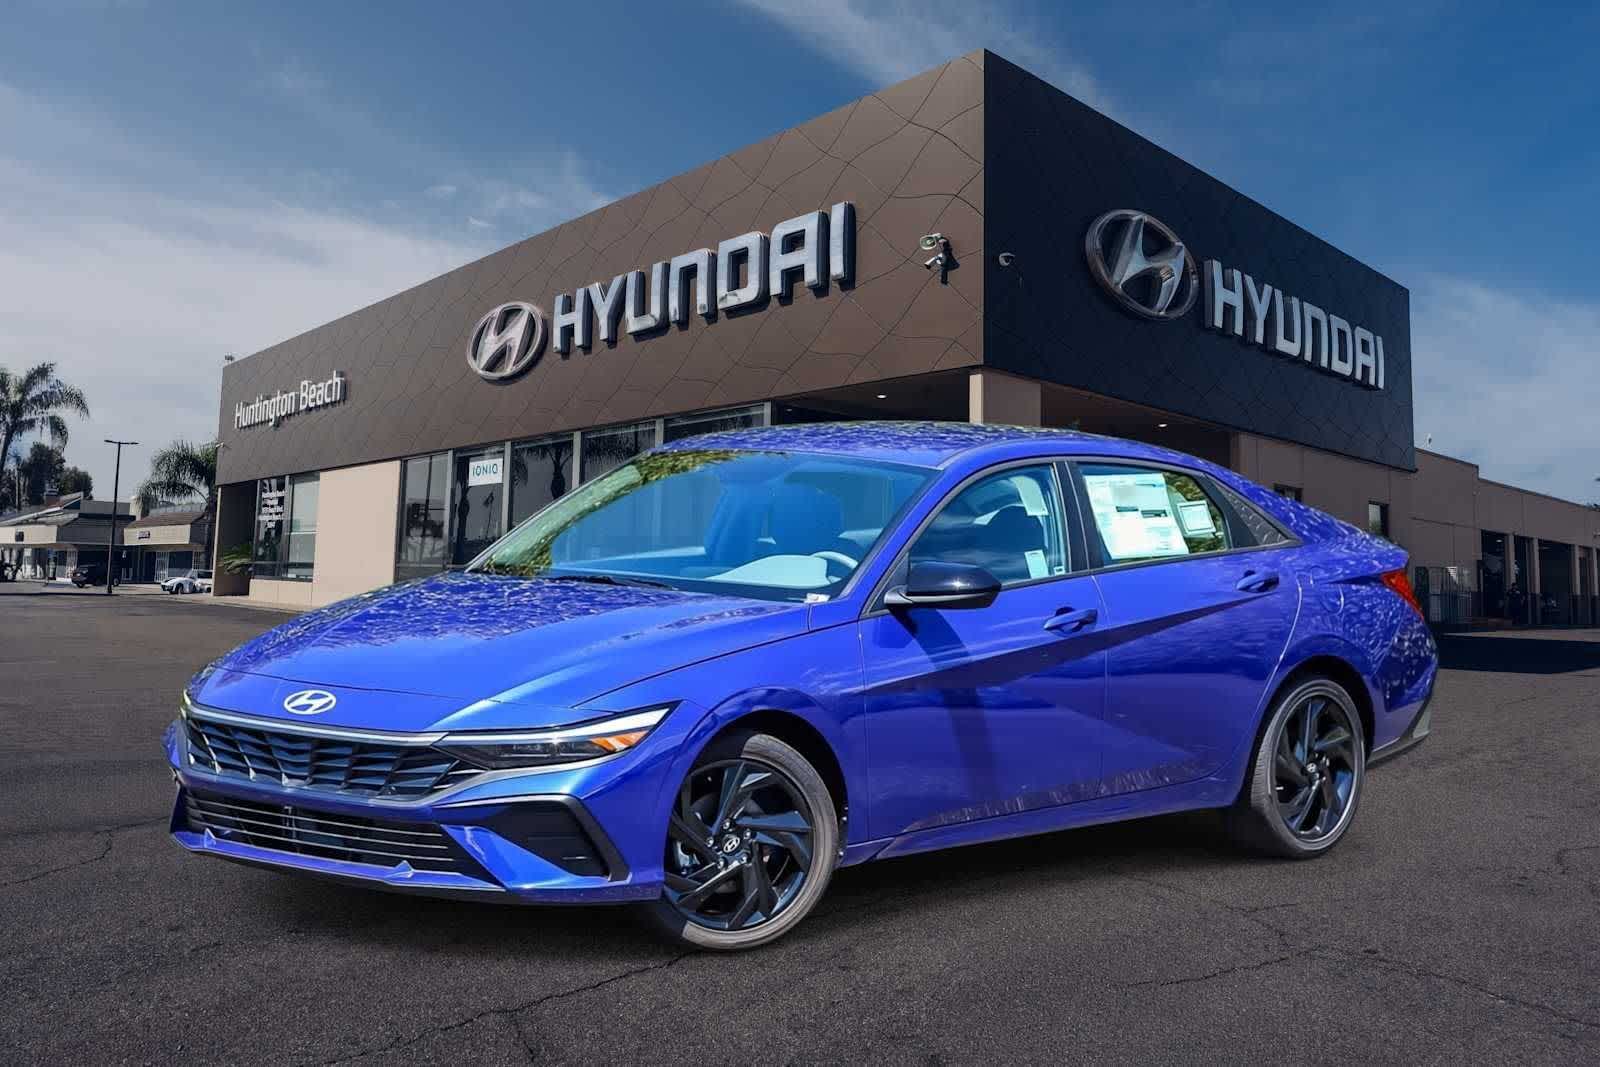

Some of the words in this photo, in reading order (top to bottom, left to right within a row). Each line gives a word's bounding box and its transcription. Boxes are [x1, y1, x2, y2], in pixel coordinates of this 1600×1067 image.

[553, 201, 854, 355] HYUNDAI
[1205, 258, 1385, 390] HYUNDAI
[234, 389, 300, 429] Huntington
[300, 370, 343, 411] Beach
